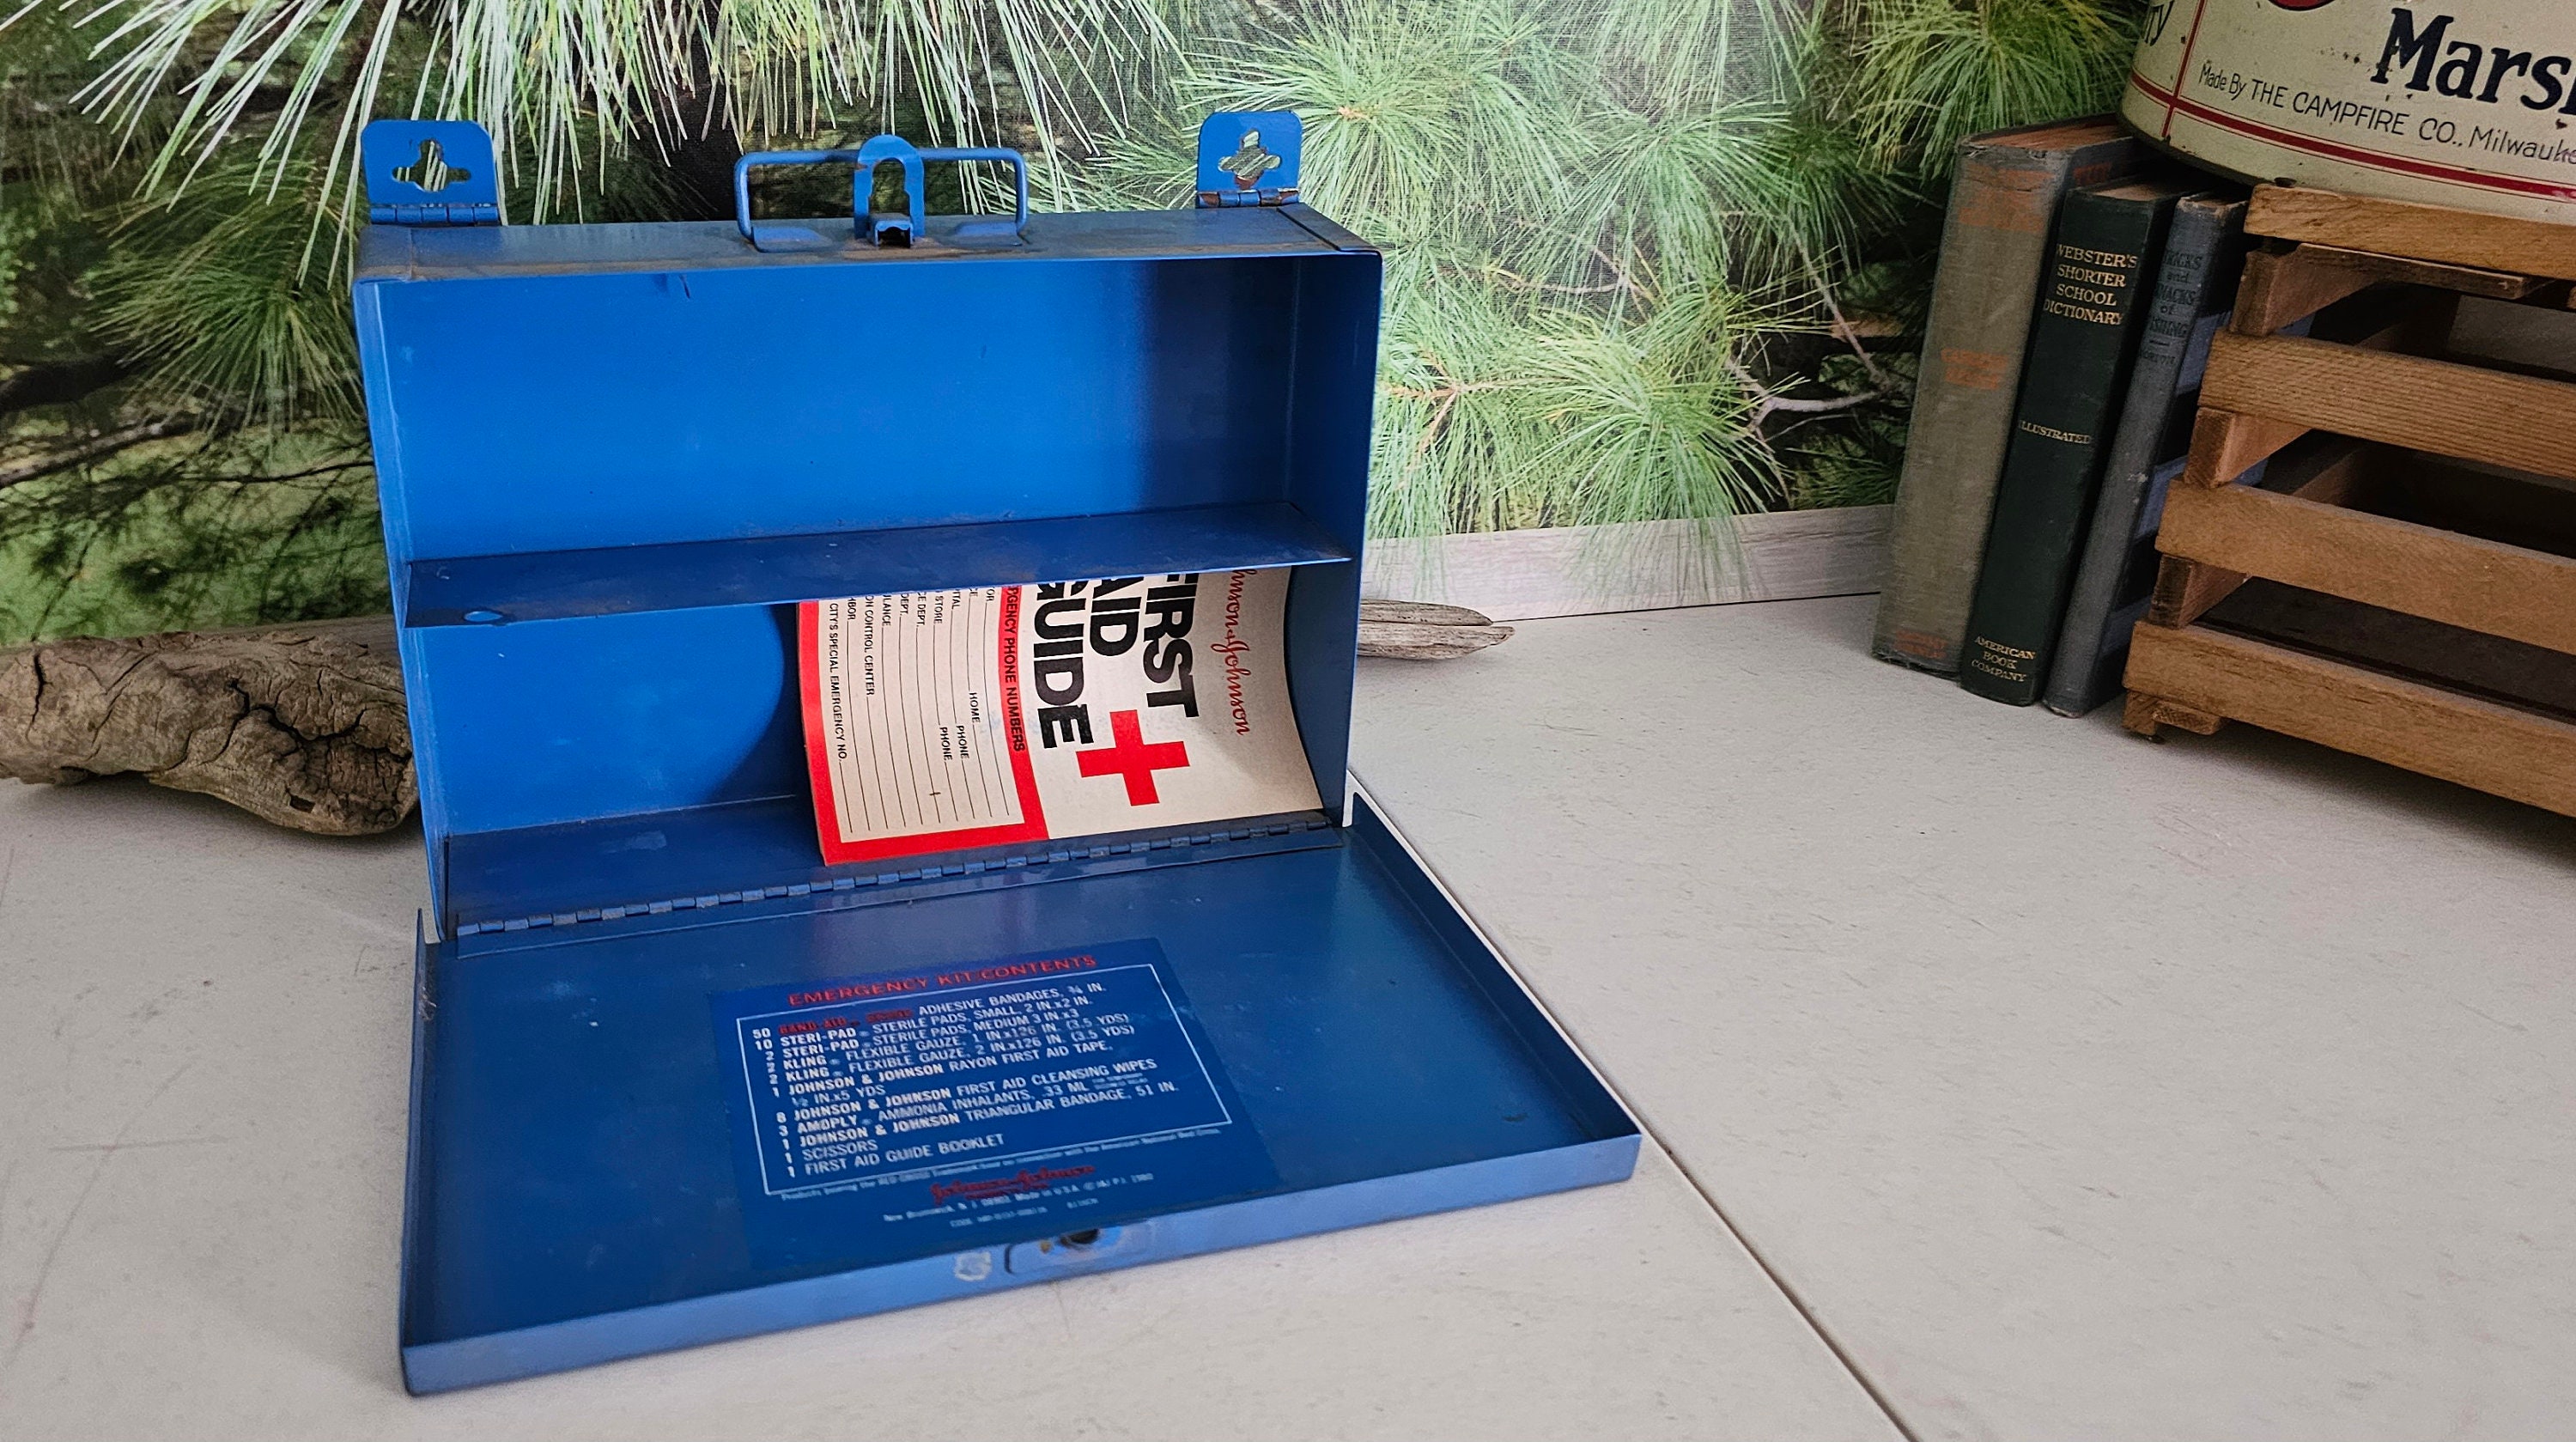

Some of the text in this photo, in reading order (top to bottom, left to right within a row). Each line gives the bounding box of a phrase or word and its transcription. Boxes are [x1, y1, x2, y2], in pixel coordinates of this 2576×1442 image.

[2370, 7, 2576, 116] Mars
[2199, 61, 2227, 91] Made
[2229, 73, 2246, 100] By
[2251, 79, 2288, 108] THE
[2293, 91, 2412, 136] CAMPFIRE
[2418, 118, 2463, 147] CO.,
[2056, 283, 2117, 307] SCHOOL
[2057, 264, 2127, 288] SHORTER
[2044, 298, 2123, 326] DICTIONARY
[916, 604, 927, 627] DEPT.
[986, 587, 995, 601] OR
[864, 610, 874, 653] CONTROL
[1975, 636, 2036, 660] AMERICAN
[829, 603, 848, 763] CITY'S SPECIAL EMERGENCY NO.
[864, 654, 875, 696] CENTER
[933, 595, 945, 624] STORE
[939, 727, 953, 761] PHONE
[951, 588, 969, 759] ITAL PHONE
[1005, 636, 1017, 683] PHONE
[1971, 659, 2026, 682] COMPANY
[1983, 651, 2018, 670] BOOK
[969, 692, 981, 723] HOME
[1005, 687, 1025, 752] NUMBERS
[788, 955, 1097, 1006] EMERGENCY KIT CONTENTS
[752, 1028, 771, 1039] 50
[919, 998, 982, 1015] ADHESIVE
[755, 1039, 773, 1050] 10
[780, 1028, 857, 1047] STERI-PAD
[872, 1017, 927, 1034] STERILE
[1024, 1003, 1033, 1013] 2
[765, 1051, 774, 1062] 2
[782, 1038, 859, 1059] STERI-PAD
[872, 1030, 927, 1046] STERILE
[973, 1015, 1030, 1031] MEDIUM
[1033, 1013, 1042, 1024] 3
[783, 1056, 826, 1070] KLING
[846, 1043, 909, 1061] FLEXIBLE
[973, 1033, 980, 1043] 1
[1066, 1019, 1092, 1031] (3.5
[1097, 1014, 1129, 1025] YDS)
[772, 1086, 780, 1098] 1
[788, 1075, 855, 1096] JOHNSON
[861, 1073, 873, 1085] &
[878, 1063, 944, 1083] JOHNSON
[949, 1056, 998, 1072] RAYON
[1001, 1049, 1040, 1064] FIRST
[1046, 1046, 1069, 1058] AID
[786, 1068, 829, 1082] KLING
[848, 1055, 914, 1074] FLEXIBLE
[975, 1044, 985, 1055] 2
[1071, 1031, 1098, 1043] (3.5
[1102, 1025, 1135, 1037] YDS)
[779, 1125, 788, 1137] 3
[878, 1102, 948, 1122] AMMONIA
[1067, 1081, 1090, 1093] ML
[794, 1100, 862, 1122] JOHNSON
[867, 1098, 880, 1110] &
[885, 1087, 951, 1108] JOHNSON
[957, 1080, 996, 1097] FIRST
[1002, 1077, 1027, 1090] AID
[1031, 1065, 1109, 1086] CLEANSING
[1112, 1058, 1158, 1074] WIPES
[856, 1084, 886, 1098] YDS
[782, 1138, 790, 1150] 1
[799, 1127, 868, 1147] JOHNSON
[875, 1123, 887, 1136] &
[892, 1113, 960, 1134] JOHNSON
[965, 1098, 1055, 1122] TRIANGULAR
[1134, 1084, 1155, 1097] 51
[785, 1140, 878, 1164] 1 SCISSORS
[787, 1133, 1005, 1178] 1 FIRST AID GUIDE BOOKLET
